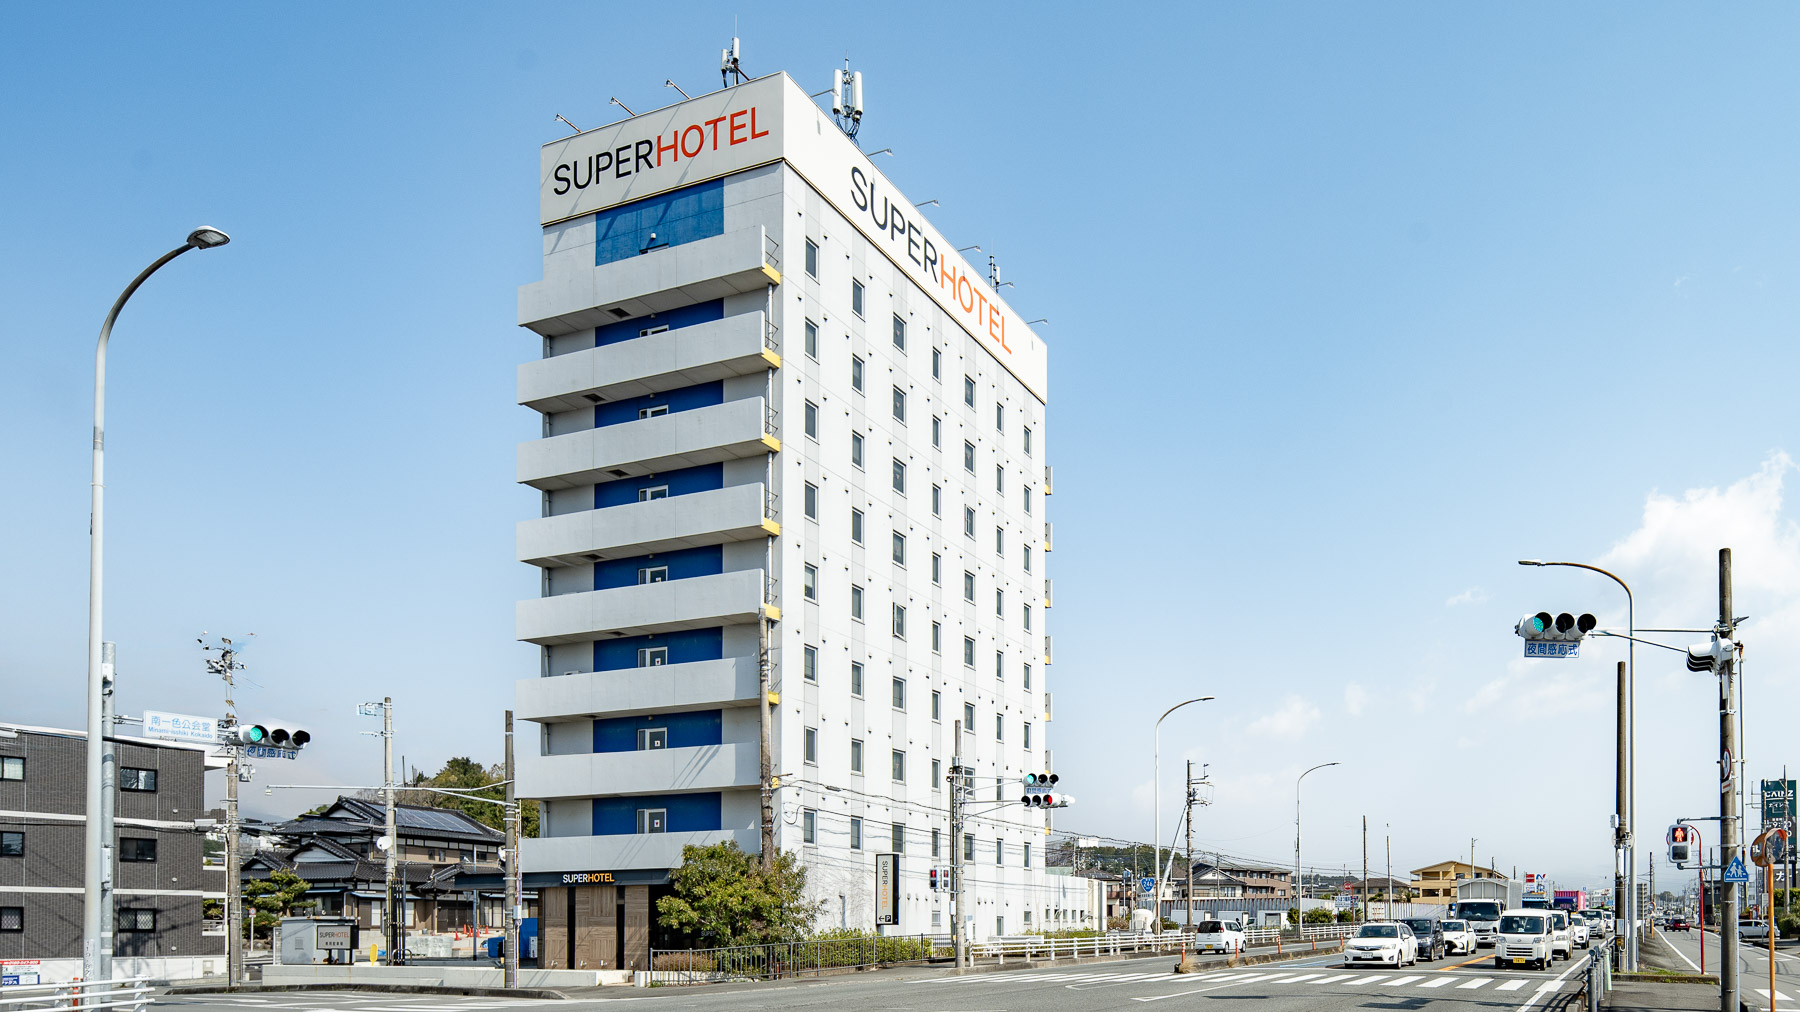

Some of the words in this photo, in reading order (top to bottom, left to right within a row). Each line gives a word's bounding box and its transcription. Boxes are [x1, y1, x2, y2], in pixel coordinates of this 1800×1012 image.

[553, 107, 769, 196] SUPERHOTEL
[851, 166, 1012, 355] SUPERHOTEL
[1527, 643, 1577, 656] 夜間感応式
[151, 715, 211, 732] 南一色公会堂
[563, 873, 615, 883] SUPERHOTEL
